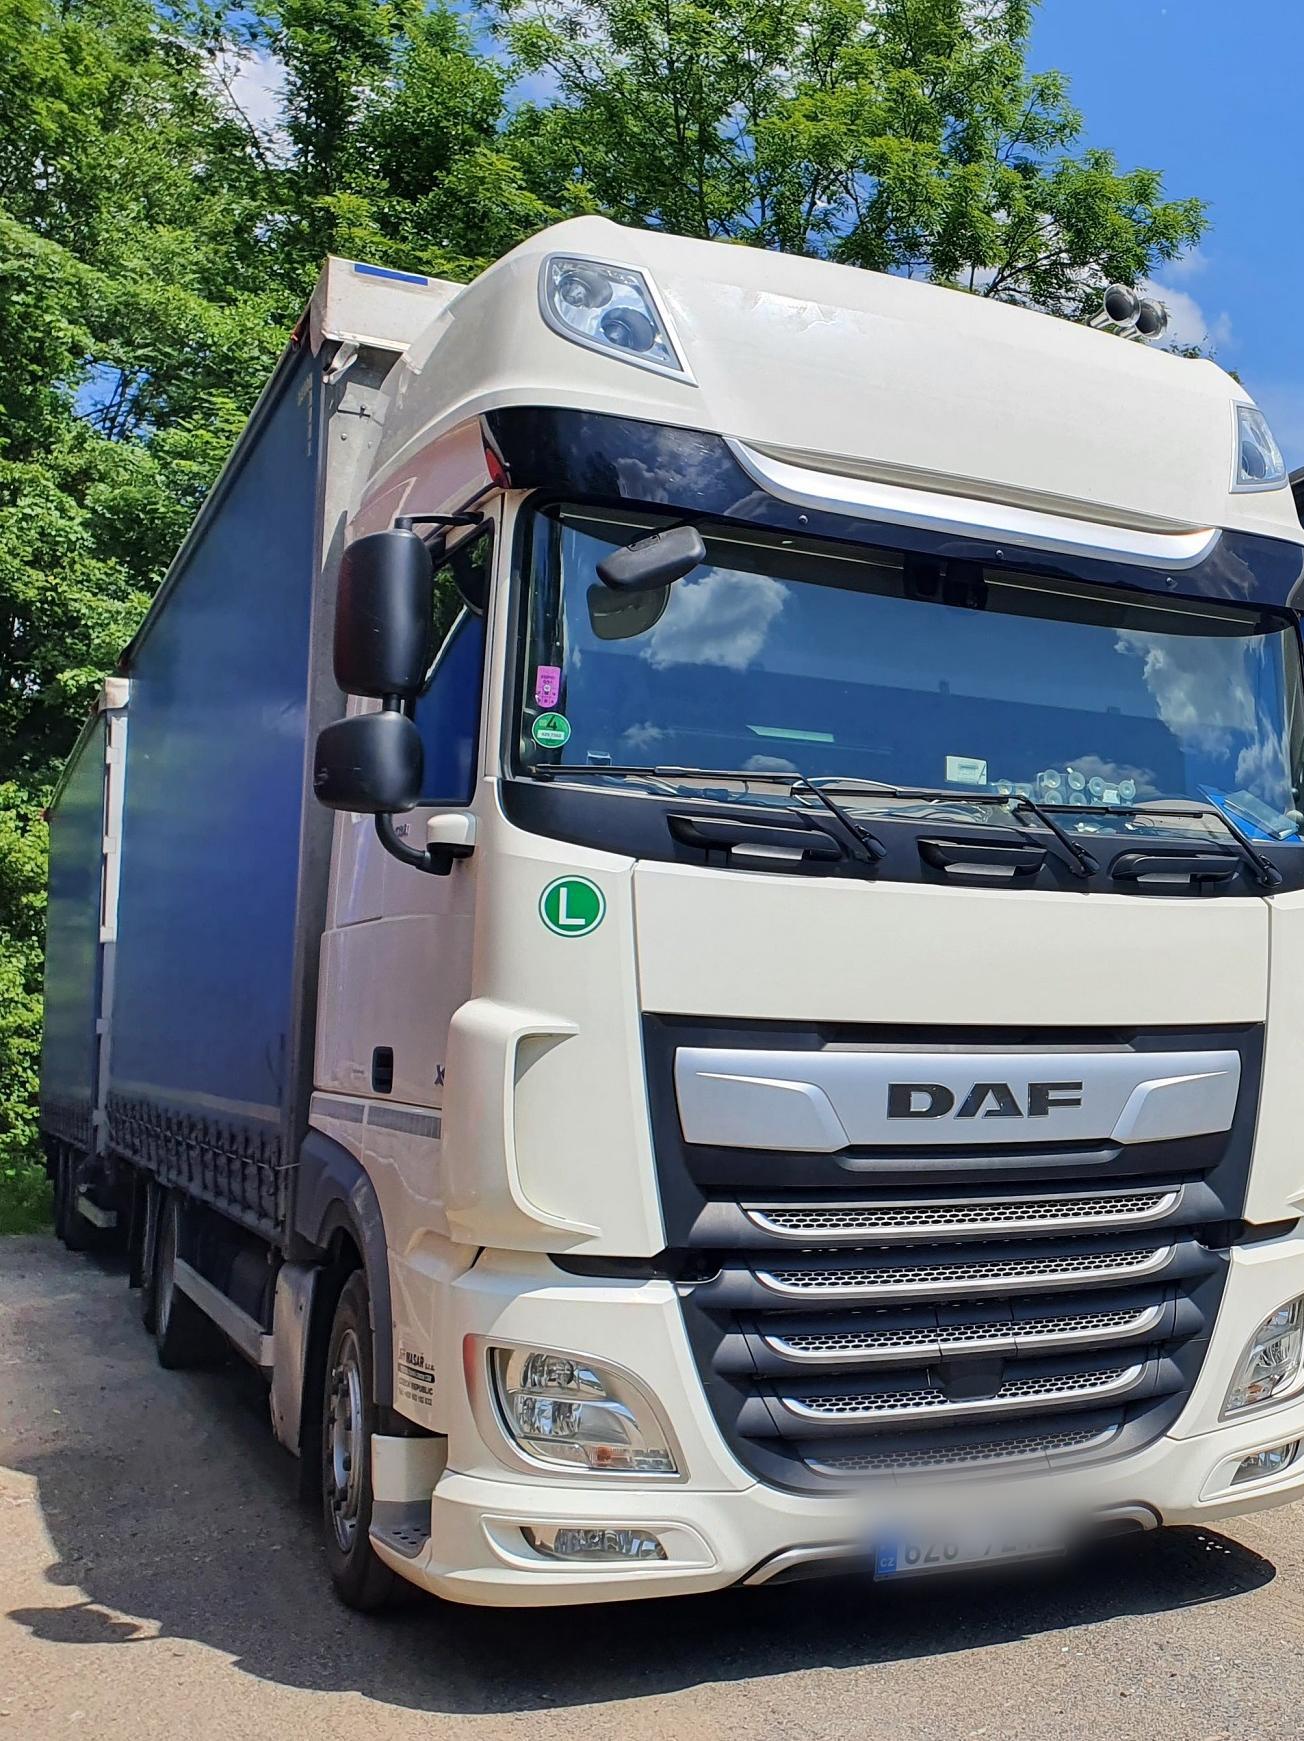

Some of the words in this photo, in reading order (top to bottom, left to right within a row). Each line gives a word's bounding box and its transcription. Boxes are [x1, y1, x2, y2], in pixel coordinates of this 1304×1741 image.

[546, 715, 558, 730] 4
[559, 887, 585, 925] L
[887, 1081, 1083, 1120] DAF
[880, 1557, 896, 1568] CZ
